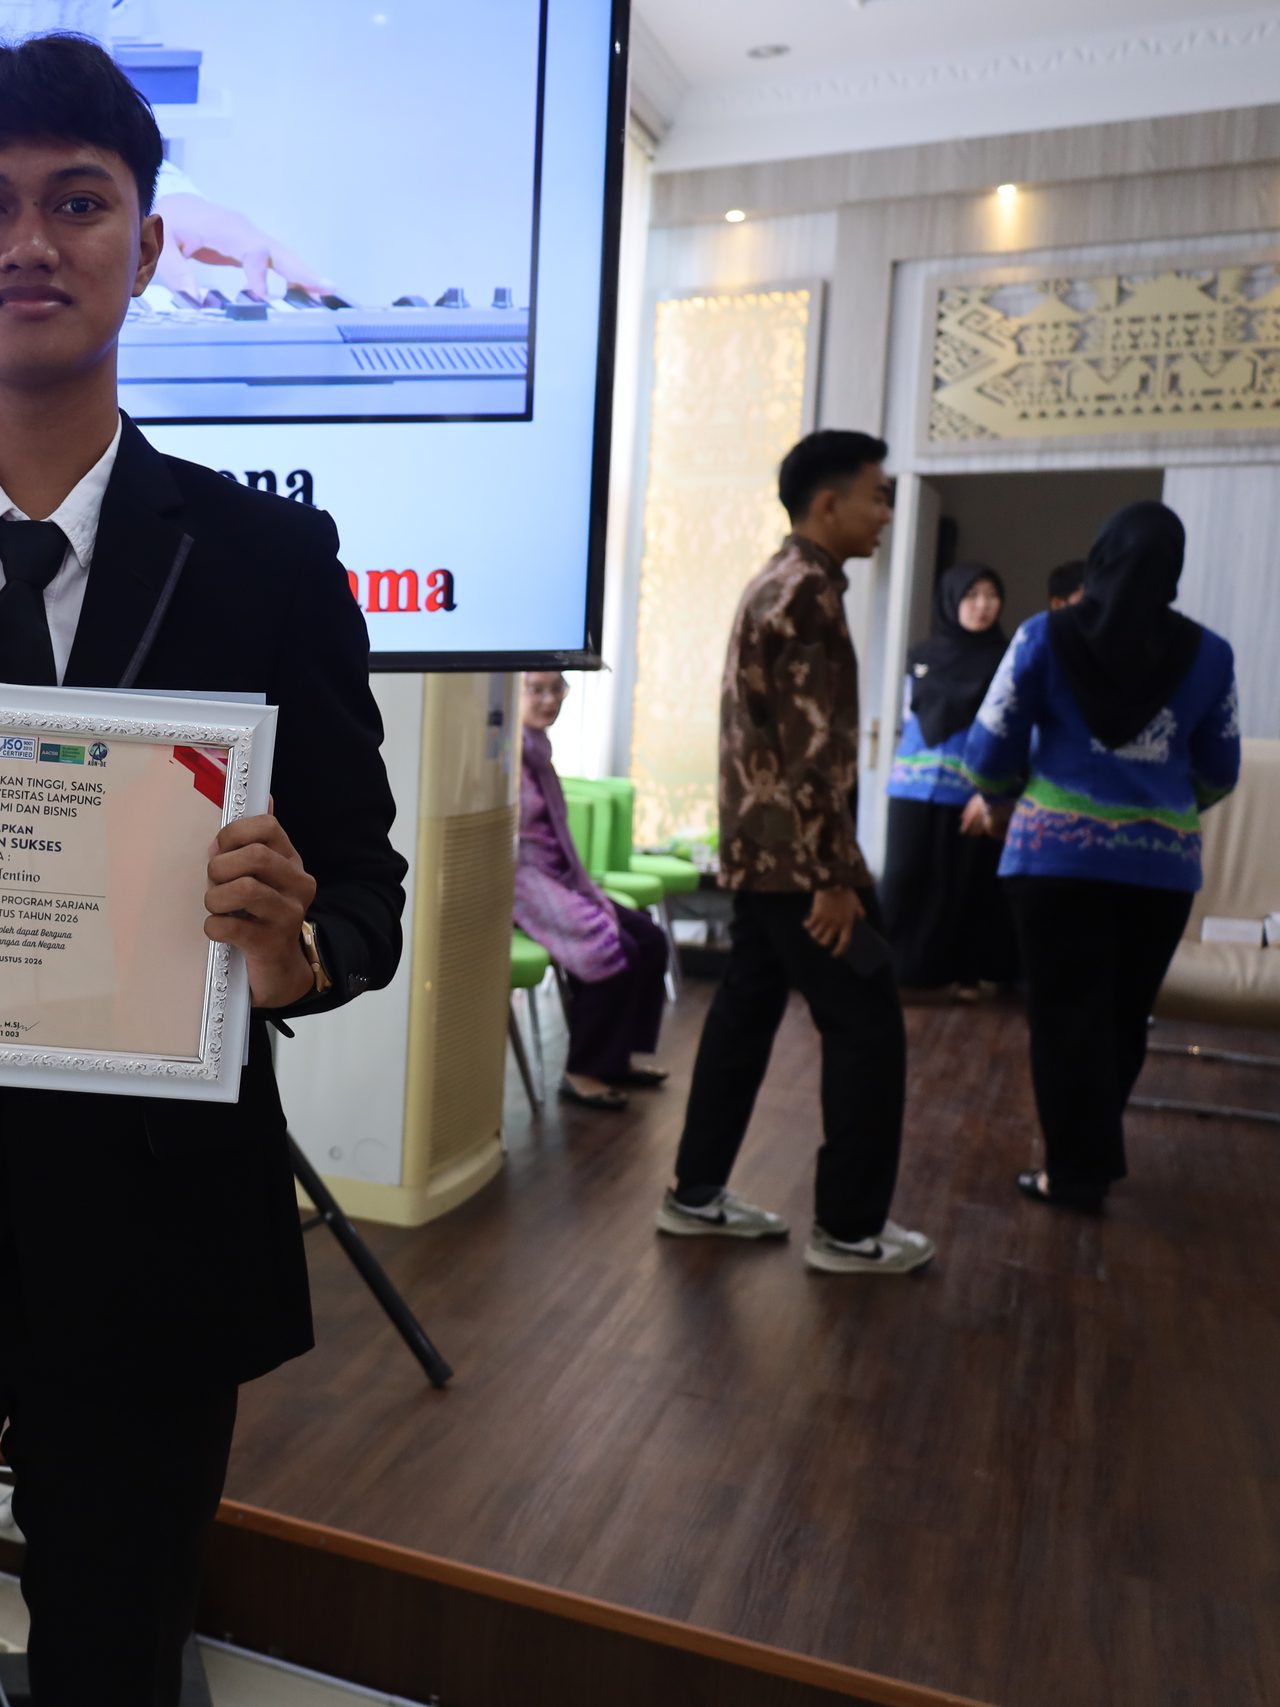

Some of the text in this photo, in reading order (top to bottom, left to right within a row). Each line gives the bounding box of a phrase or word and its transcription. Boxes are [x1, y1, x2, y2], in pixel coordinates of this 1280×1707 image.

[3, 738, 23, 750] ISO
[2, 750, 33, 758] CERTIFIED
[27, 777, 68, 791] TINGGI,
[70, 781, 106, 795] SAINS,
[47, 792, 102, 806] LAMPUNG
[16, 803, 41, 815] DAN
[43, 806, 77, 818] BISNIS
[11, 839, 62, 853] SUKSES
[1, 895, 53, 908] PROGRAM
[55, 899, 99, 912] SARJANA
[18, 911, 52, 922] TAHUN
[55, 912, 79, 924] 2026
[16, 927, 39, 938] dapat
[40, 929, 72, 940] Berguna
[22, 938, 37, 948] dan
[38, 941, 66, 950] Negara
[24, 957, 43, 965] 2026
[5, 1030, 20, 1038] 003
